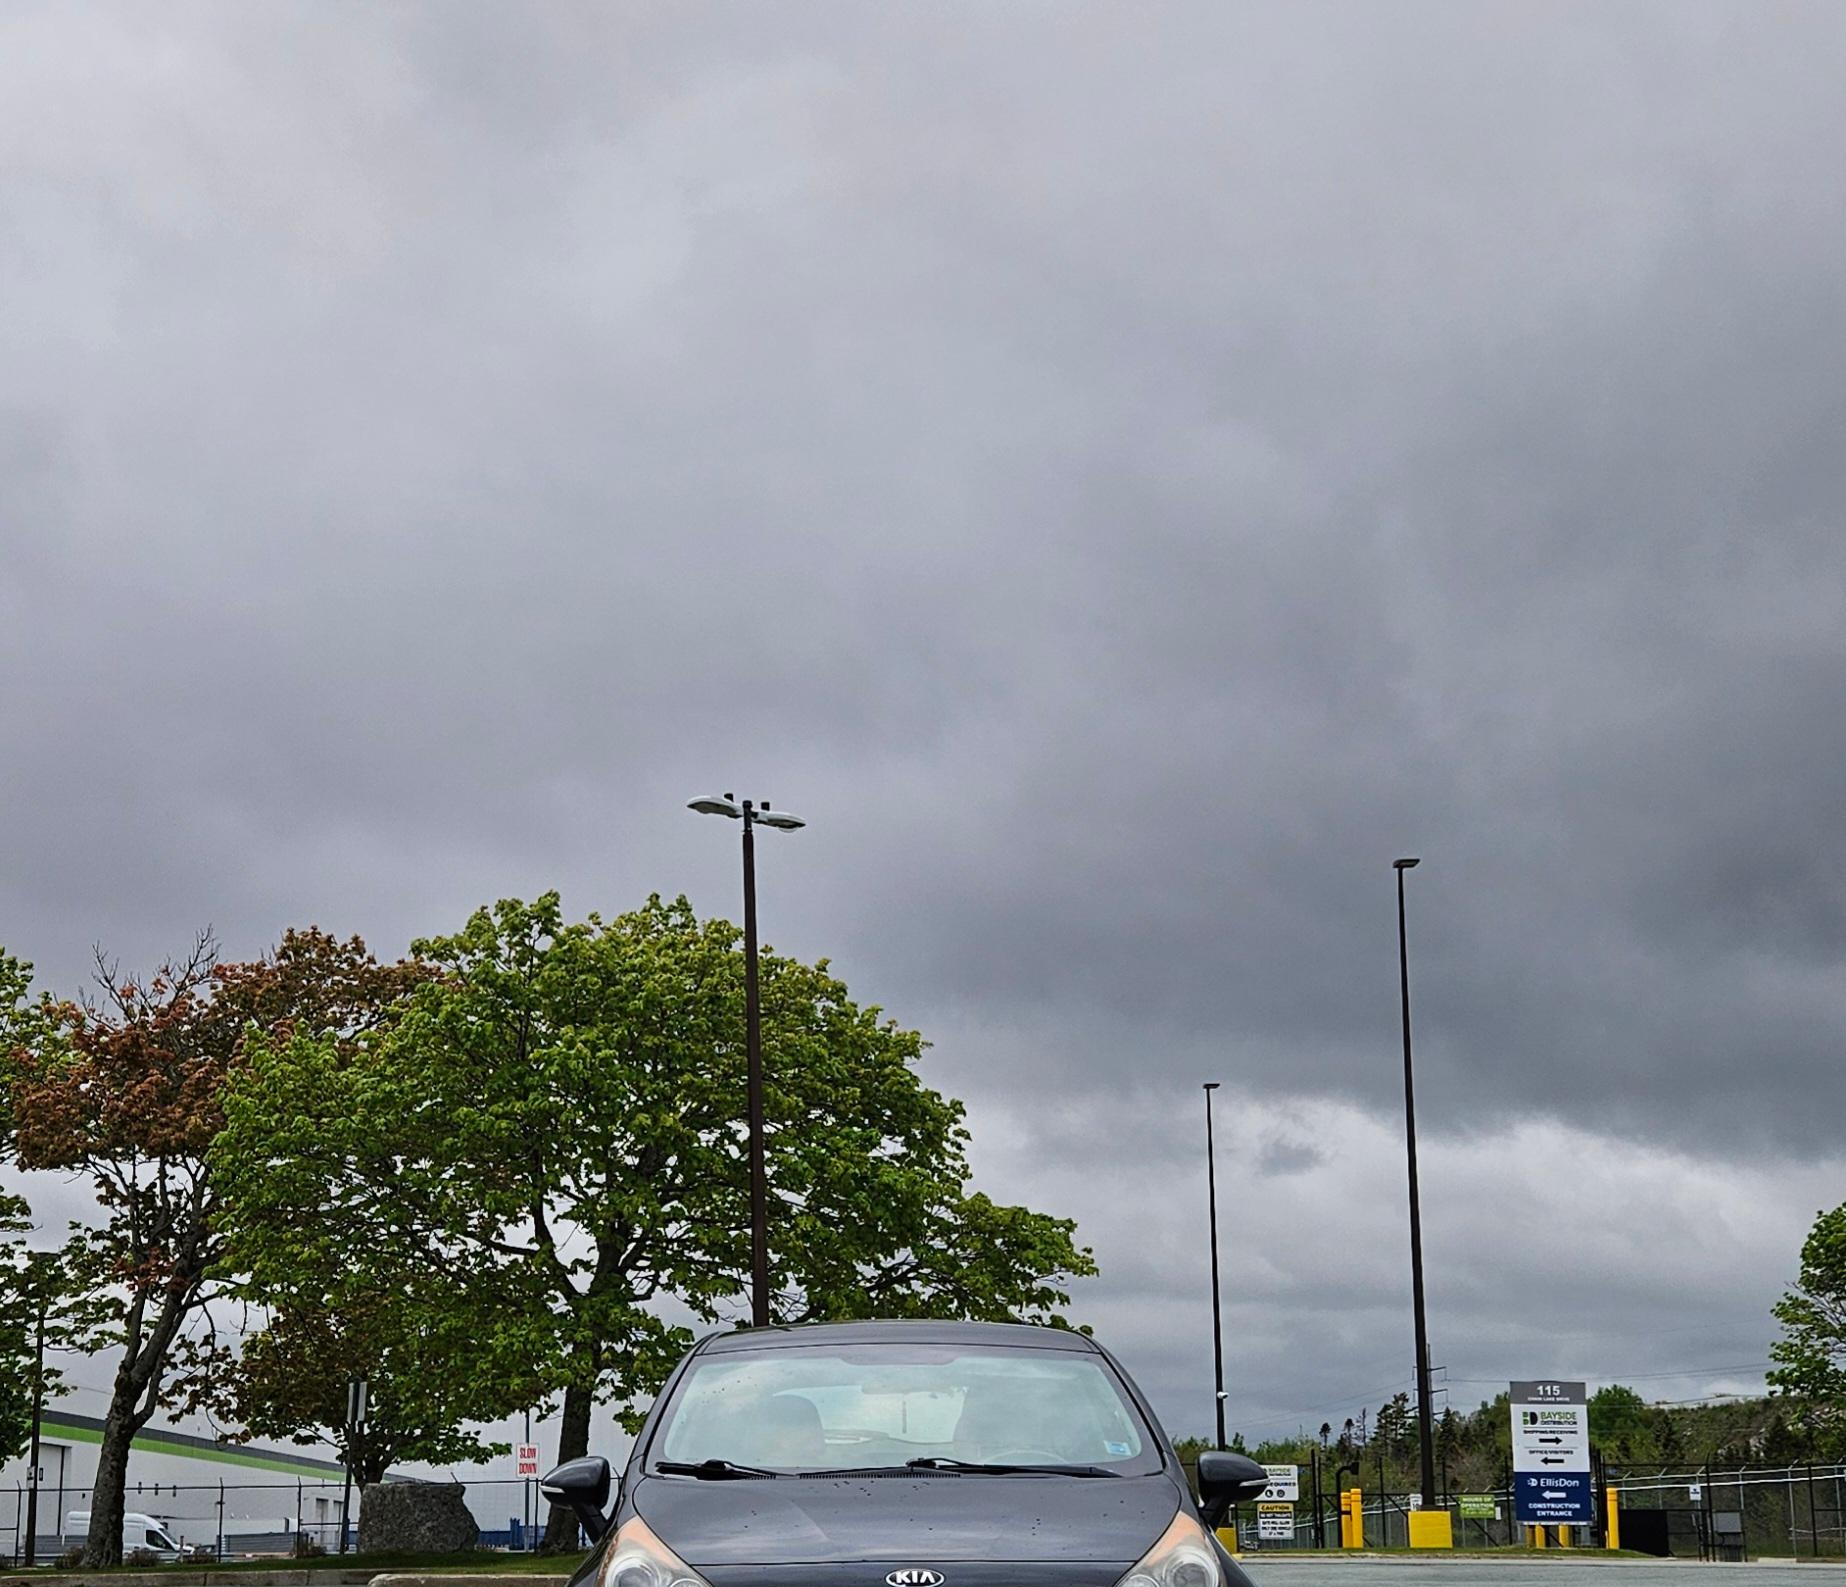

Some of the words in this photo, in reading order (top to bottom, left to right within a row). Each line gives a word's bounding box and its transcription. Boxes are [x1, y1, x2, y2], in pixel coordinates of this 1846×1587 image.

[1536, 1385, 1561, 1396] 115
[1540, 1411, 1577, 1421] BAYSIDE
[519, 1447, 536, 1458] SLOW
[519, 1463, 537, 1474] DOWN
[1540, 1478, 1580, 1487] EllisDon
[895, 1570, 936, 1584] KIA
